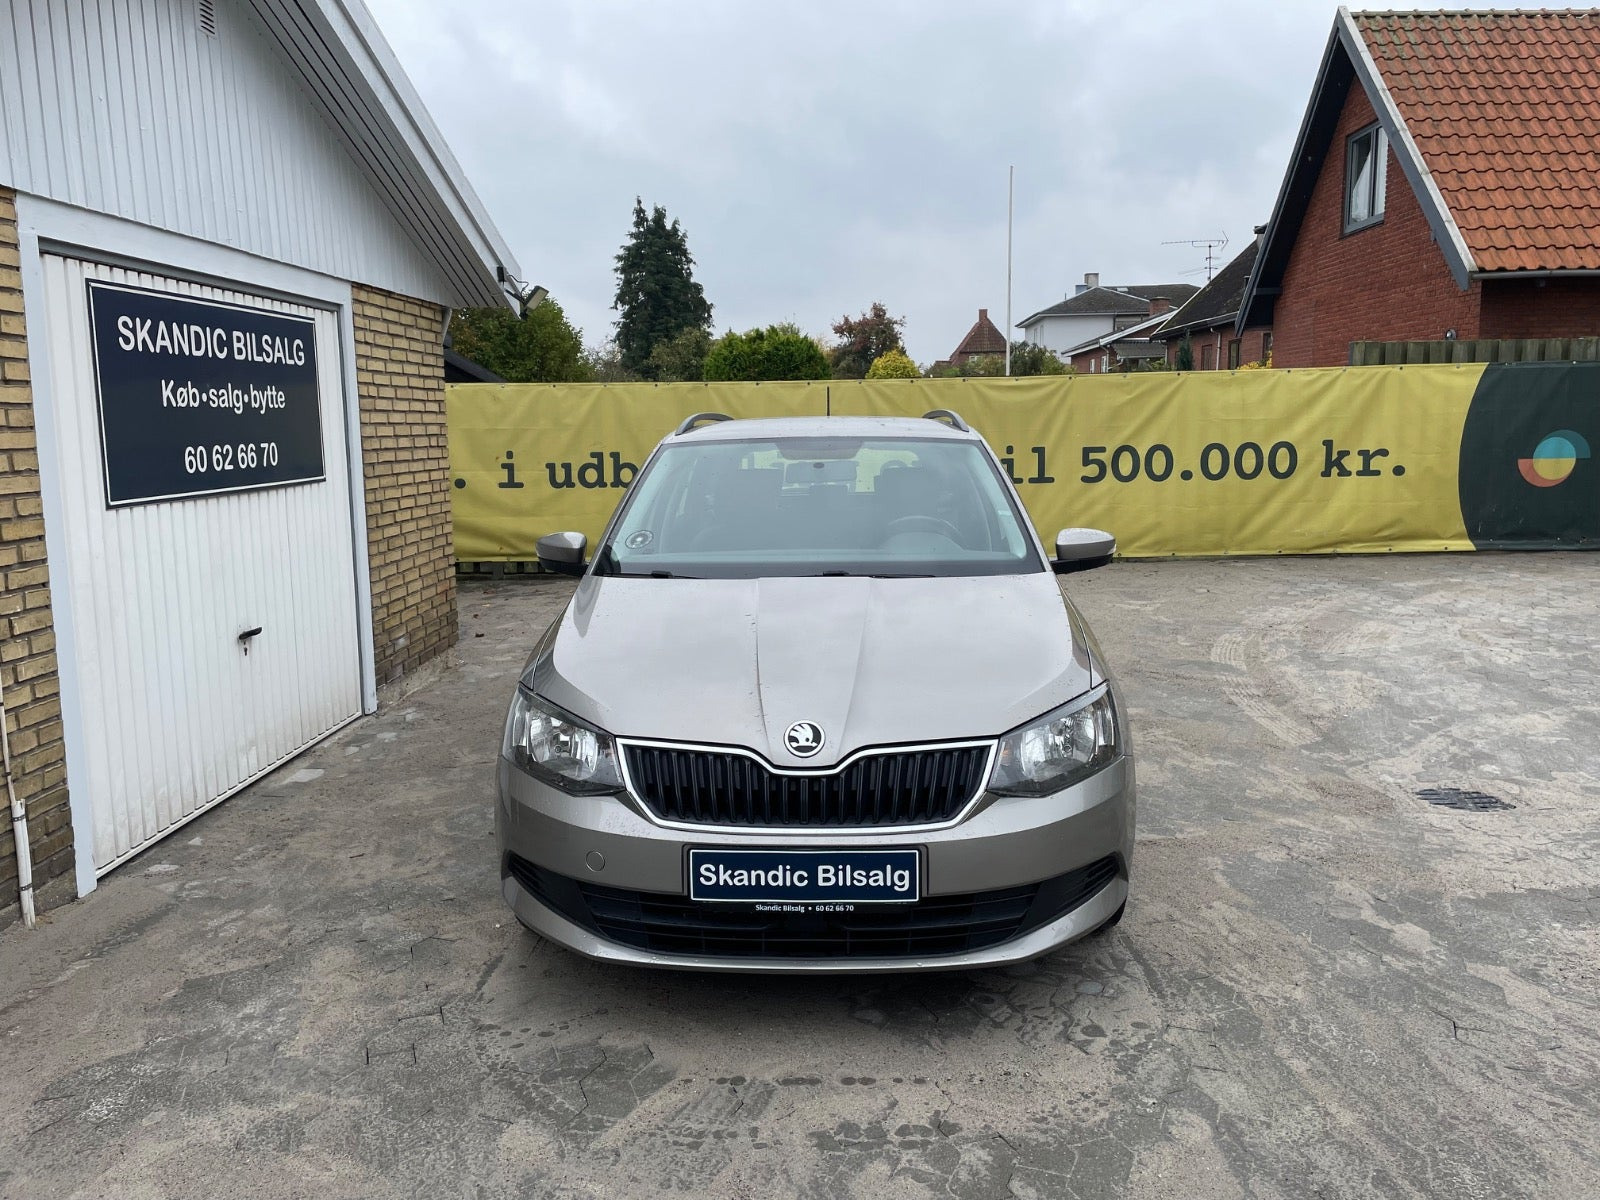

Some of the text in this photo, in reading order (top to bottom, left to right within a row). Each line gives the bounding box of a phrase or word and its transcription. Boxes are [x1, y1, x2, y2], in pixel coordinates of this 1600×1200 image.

[117, 315, 305, 366] SKANDIC BILSALG
[184, 442, 278, 474] 60 62 66 70
[498, 450, 639, 489] i udb
[1000, 439, 1406, 484] il 500.000 kr.
[699, 863, 910, 892] Skandic Bilsalg
[755, 904, 782, 912] Skandic
[782, 904, 805, 913] Bilsalg
